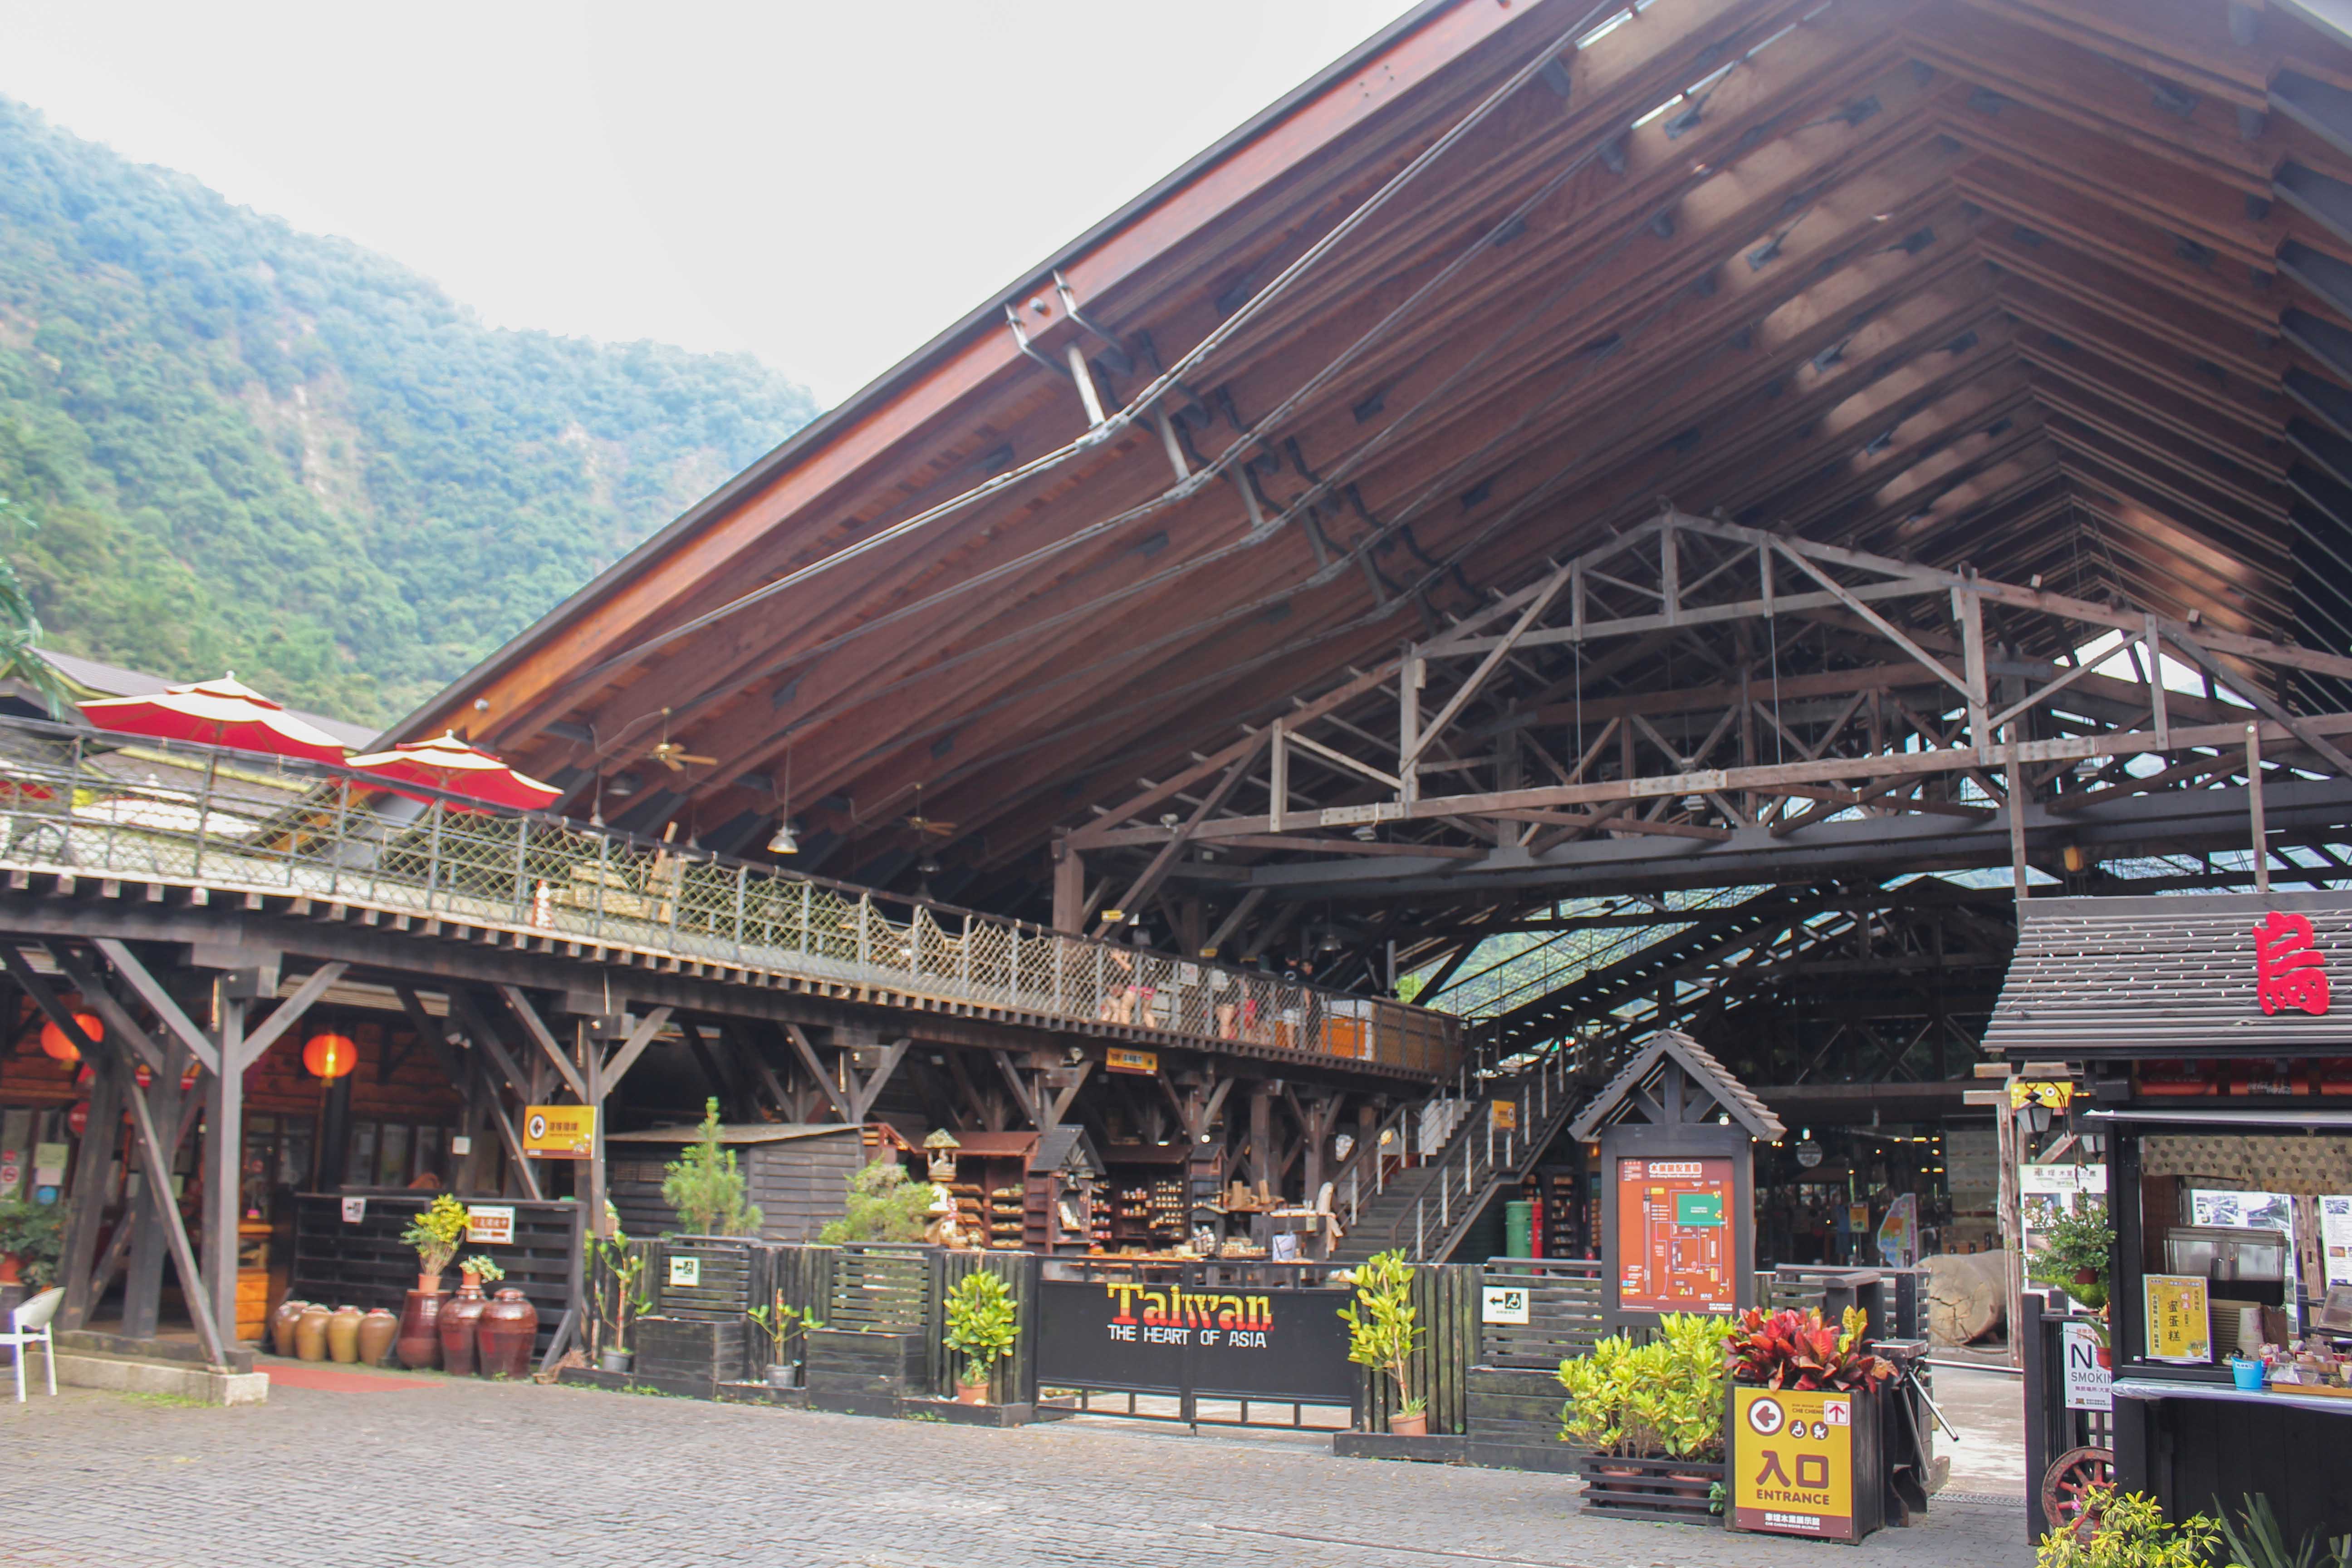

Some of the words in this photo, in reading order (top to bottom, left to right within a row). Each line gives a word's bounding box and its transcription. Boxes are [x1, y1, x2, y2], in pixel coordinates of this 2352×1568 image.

[1107, 1283, 1273, 1331] Taiwan
[1107, 1324, 1136, 1342] THE
[1143, 1326, 1191, 1345] HEART
[1200, 1329, 1220, 1346] OF
[1228, 1331, 1267, 1348] ASIA
[2071, 1343, 2094, 1370] N
[1756, 1450, 1828, 1489] 入口
[1756, 1489, 1829, 1505] ENTRANCE
